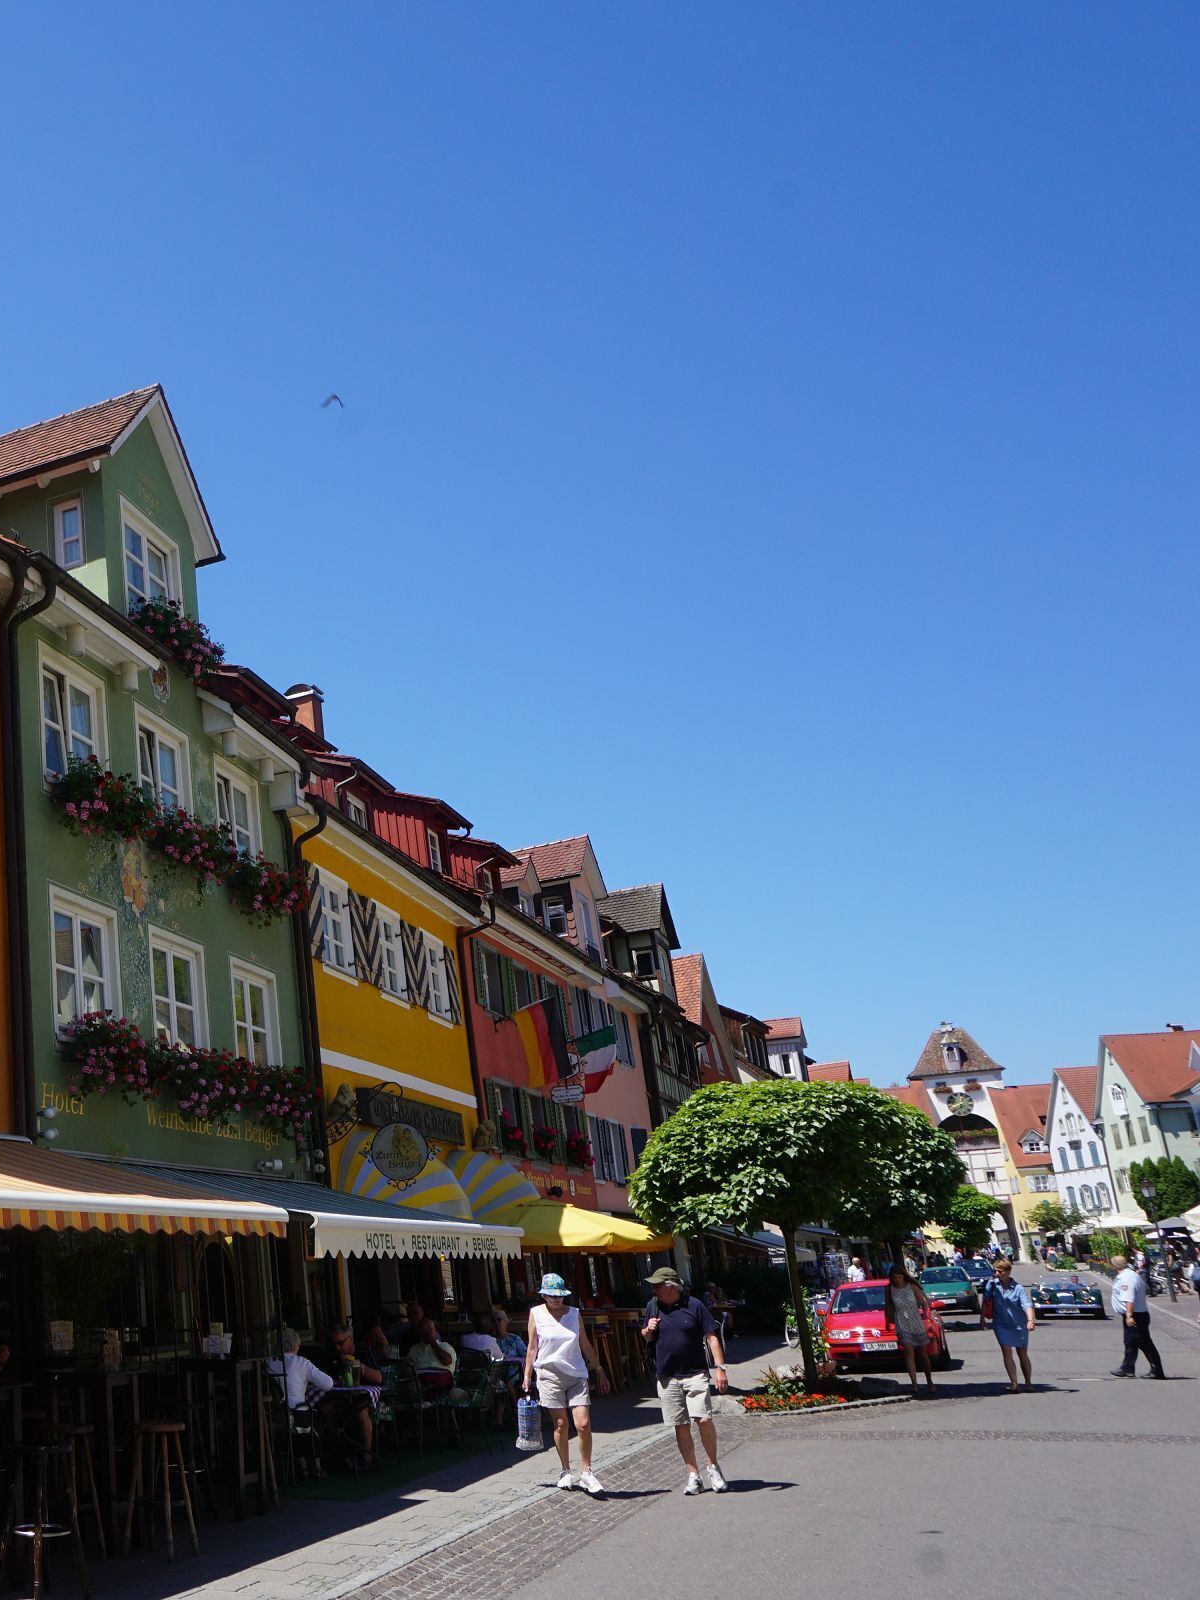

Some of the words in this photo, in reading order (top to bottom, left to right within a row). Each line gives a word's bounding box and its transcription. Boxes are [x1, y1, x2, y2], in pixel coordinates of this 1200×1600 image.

[40, 1082, 86, 1115] Hotel
[146, 1102, 212, 1136] Weinstube
[245, 1119, 280, 1151] Bengel
[376, 1151, 401, 1160] Zum
[388, 1159, 422, 1169] Bengel
[366, 1232, 396, 1250] HOTEL
[411, 1235, 461, 1251] RESTAURANT
[472, 1237, 499, 1252] BENGEL
